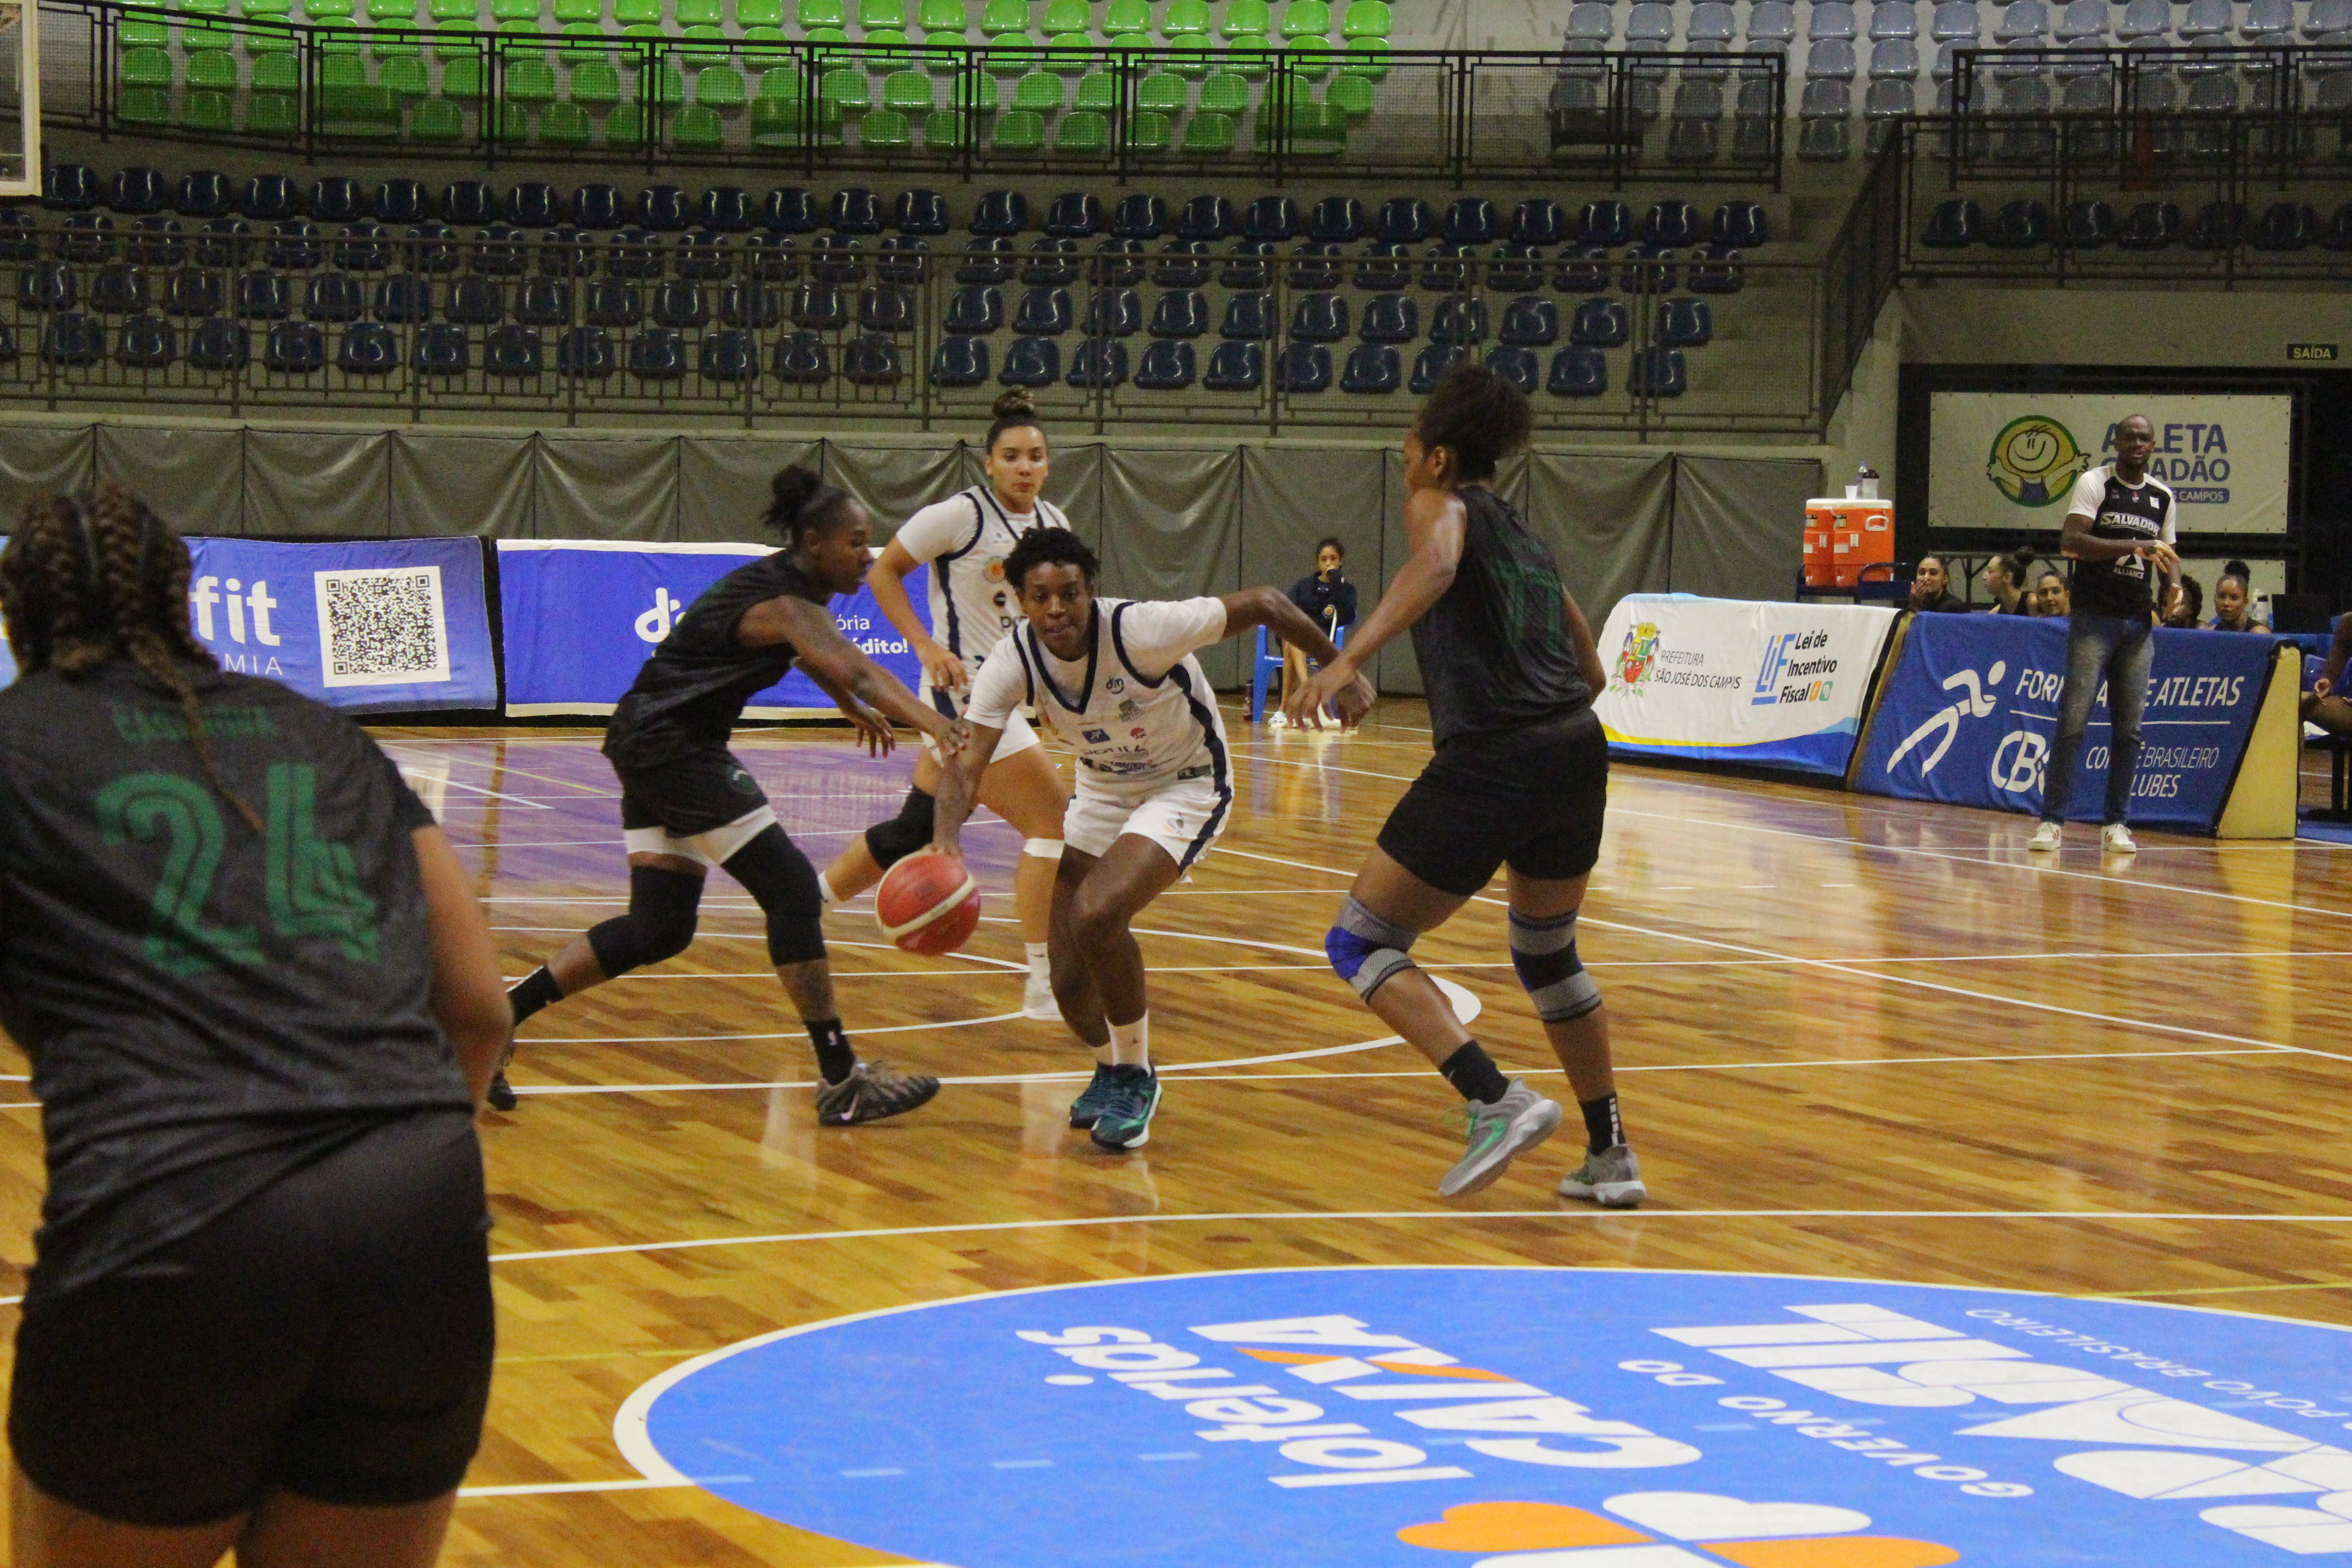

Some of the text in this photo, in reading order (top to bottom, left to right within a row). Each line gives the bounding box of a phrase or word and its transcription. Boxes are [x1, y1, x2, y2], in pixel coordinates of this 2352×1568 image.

[2293, 345, 2331, 359] SAÍDA
[2101, 455, 2230, 482] ADÃO
[2179, 490, 2225, 501] CAMPOS
[2100, 513, 2161, 536] SALVADOR
[2113, 567, 2145, 580] ALLIANCE
[188, 575, 281, 647] fit
[835, 613, 871, 631] ória
[1794, 629, 1828, 650] Lei de
[1661, 650, 1704, 666] PREFEITURA
[1787, 655, 1838, 677] Incentivo
[1654, 668, 1671, 684] SÃO
[1671, 670, 1692, 686] JOSÉ
[1690, 673, 1708, 687] DOS
[1779, 682, 1812, 704] Fiscal
[2156, 676, 2245, 707] ATLETAS
[2142, 747, 2220, 769] BRASILEIRO
[2130, 774, 2182, 798] LUBES
[1965, 1309, 2351, 1419] POVO BRASILEIRO
[1187, 1314, 1702, 1469] CAIXA
[1015, 1326, 1474, 1489] loterias
[1617, 1359, 2034, 1498] GOVERNO DO
